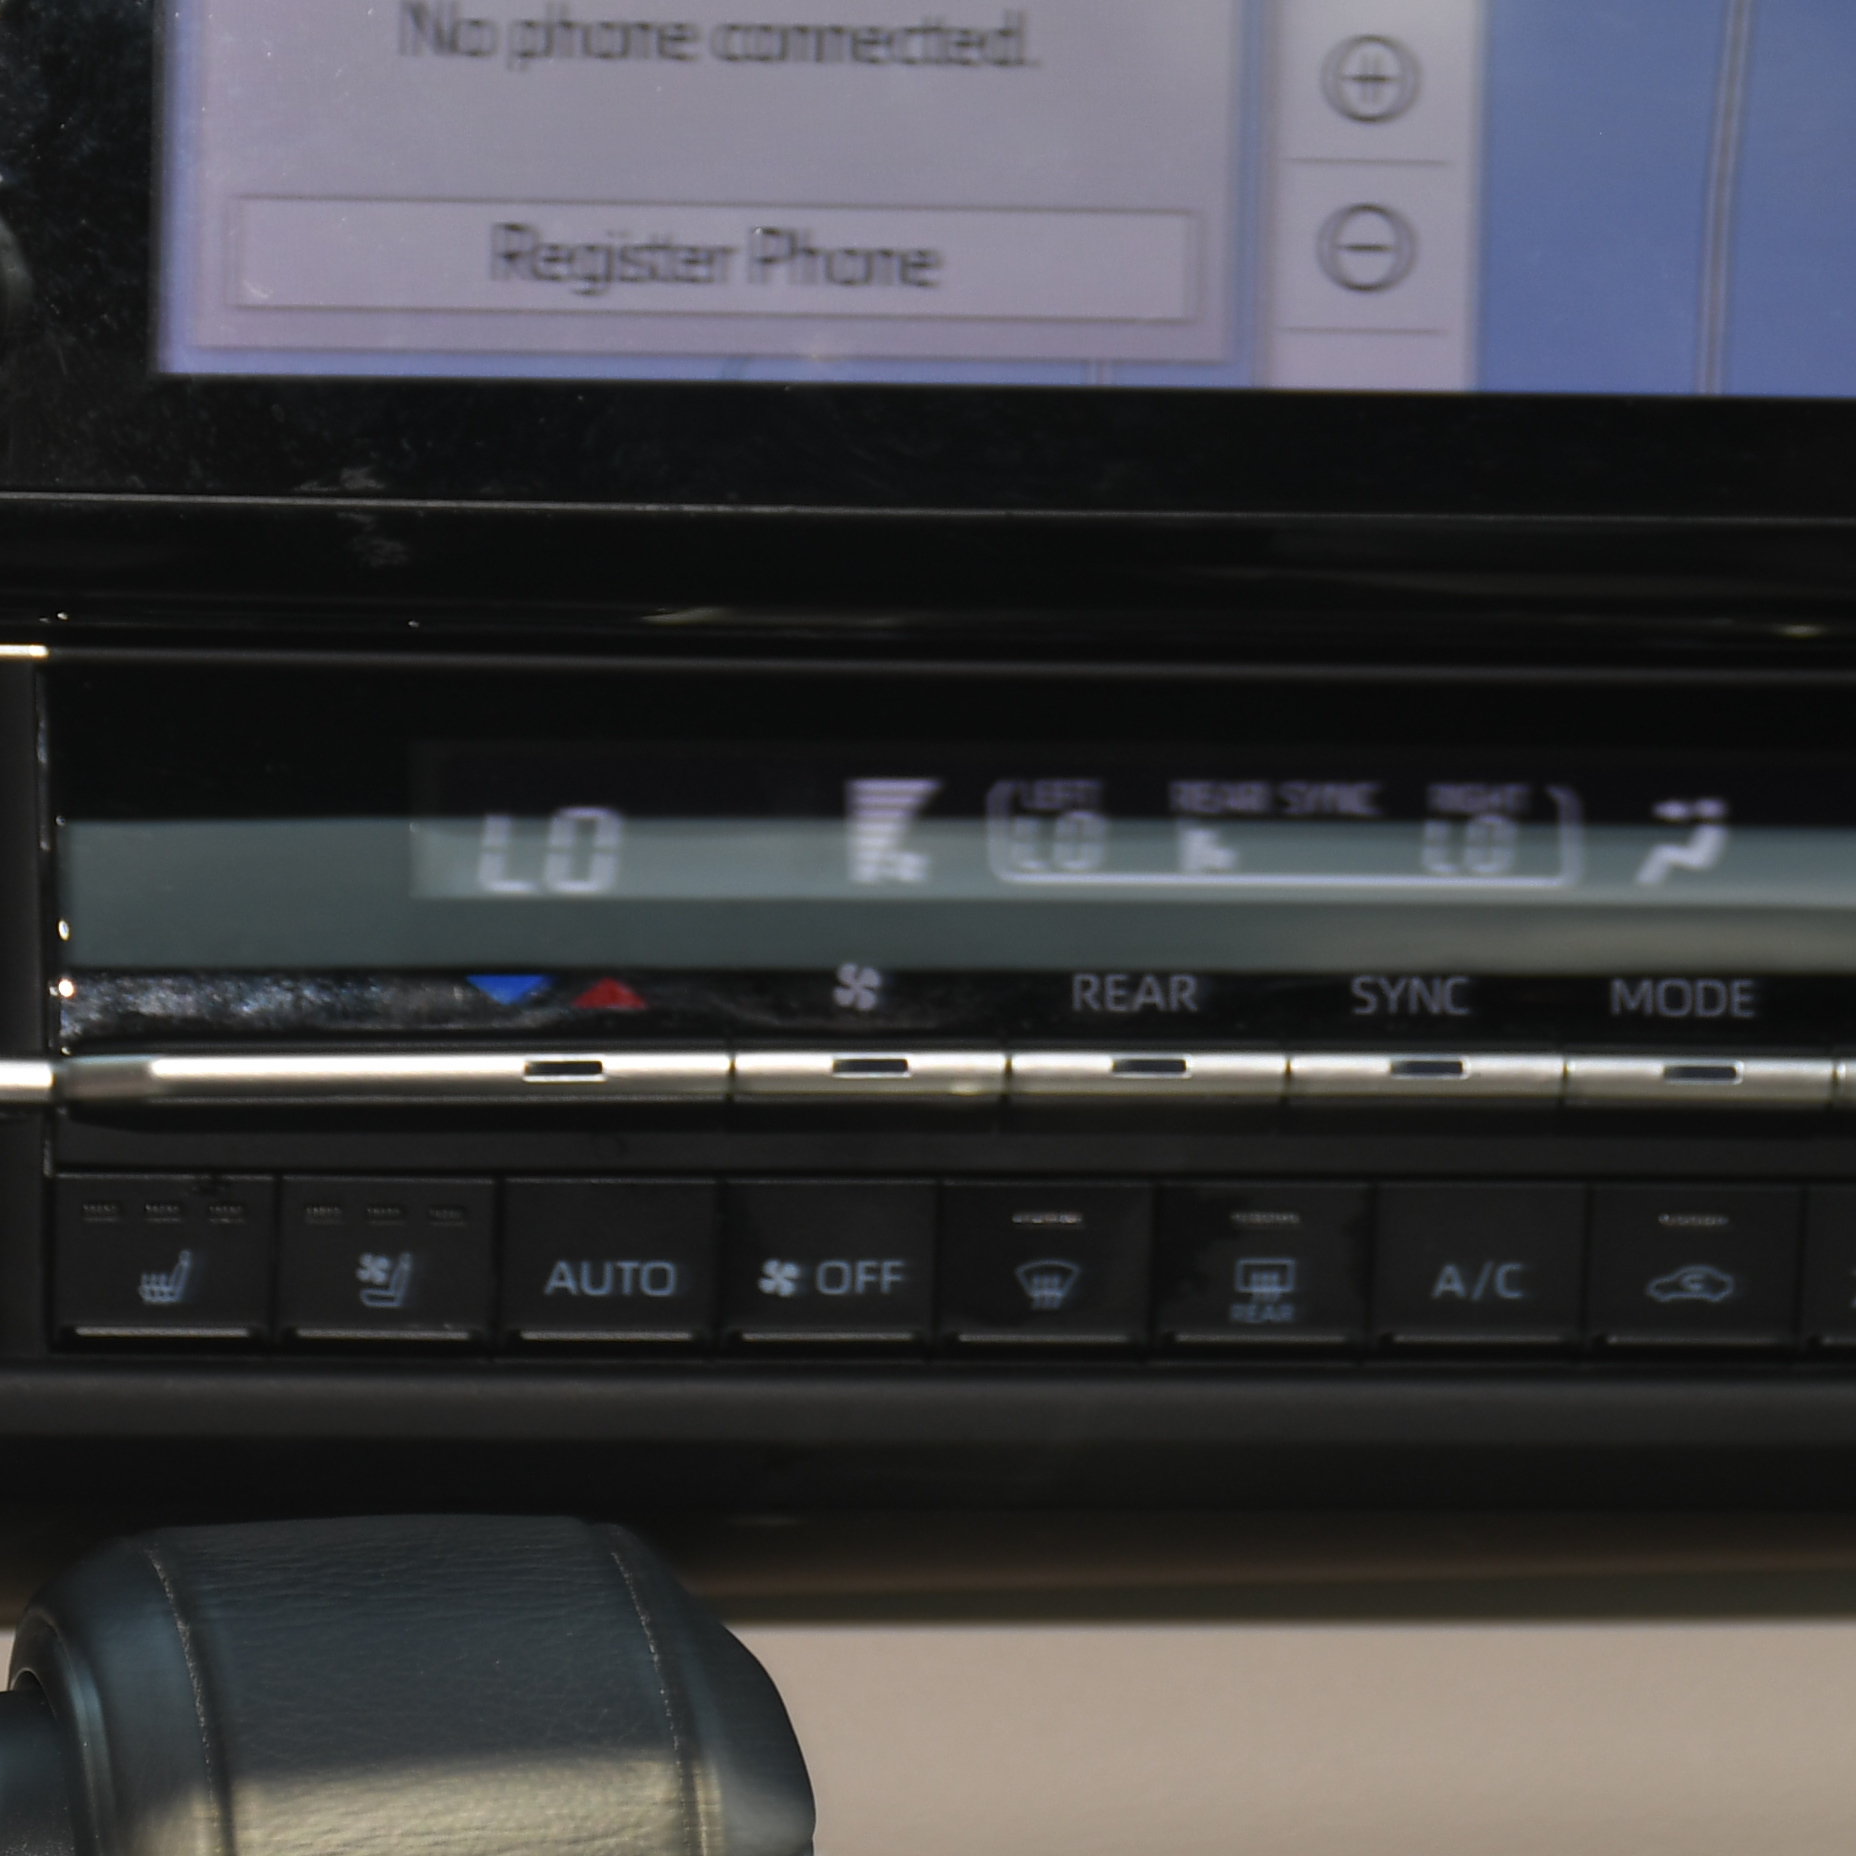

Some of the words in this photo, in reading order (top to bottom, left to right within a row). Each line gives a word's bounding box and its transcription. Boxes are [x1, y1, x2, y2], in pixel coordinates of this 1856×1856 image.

[508, 1, 699, 73] phone
[488, 221, 736, 296] Register
[750, 227, 942, 288] Phone
[1072, 974, 1200, 1012] REAR
[1350, 977, 1473, 1016] SYNC
[1611, 979, 1757, 1018] MODE
[544, 1259, 679, 1297] AUTO
[816, 1259, 909, 1297] OFF
[1433, 1263, 1526, 1302] A/C
